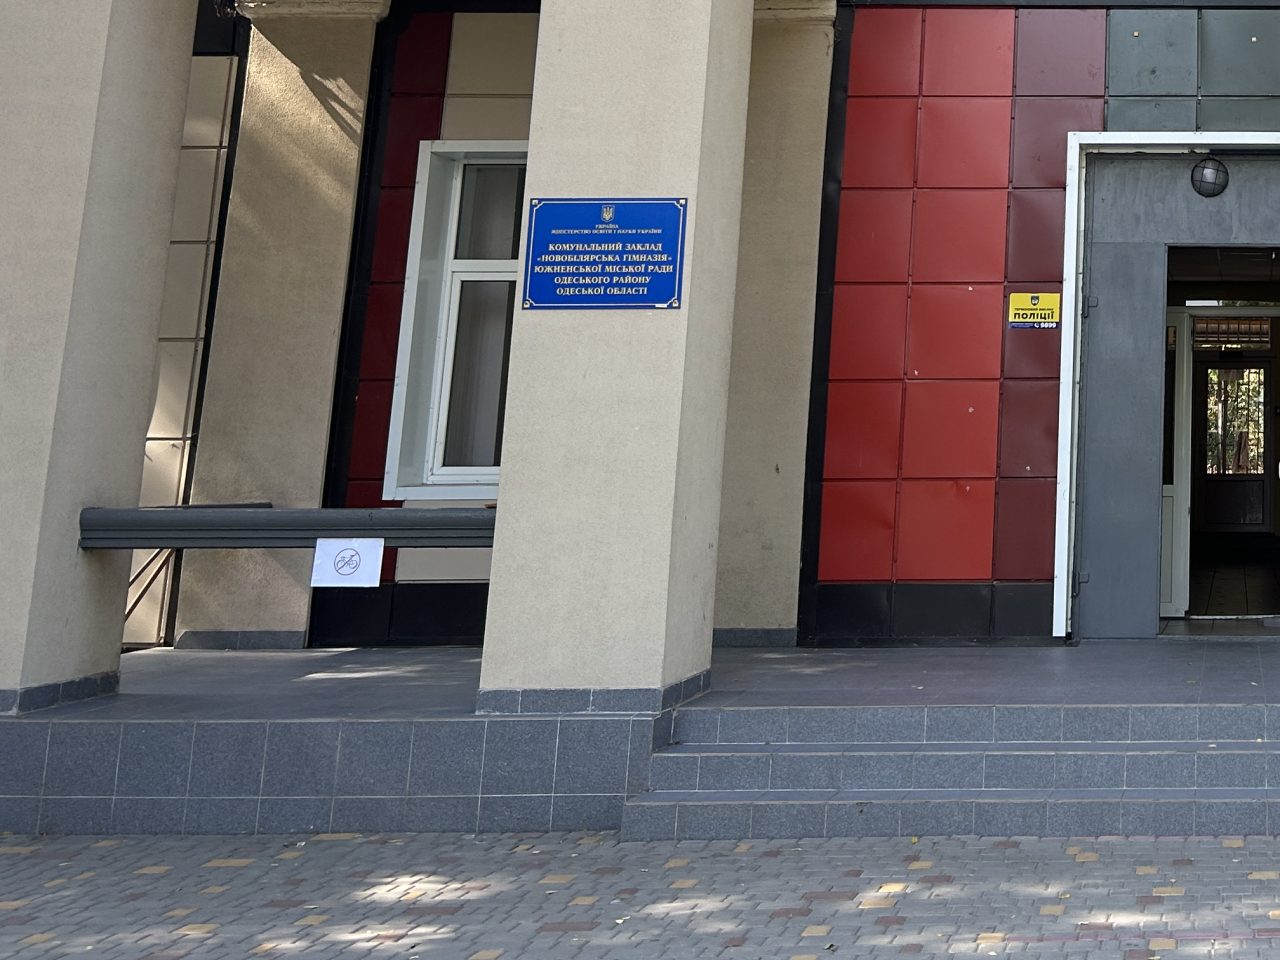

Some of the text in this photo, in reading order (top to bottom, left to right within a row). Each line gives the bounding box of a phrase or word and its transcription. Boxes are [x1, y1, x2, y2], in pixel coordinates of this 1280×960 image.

[549, 242, 662, 251] КОМУНАЛЬНИЙ ЗАКЛАД
[537, 254, 672, 262] «НОВОБІЛЯРСЬКА ГІМНАЗІЯ»
[534, 265, 673, 274] ЮЖНЕНСЬКОЇ МІСЬКОЇ РАДИ
[554, 275, 652, 285] ОДЕСЬКОГО РАЙОНУ
[556, 286, 648, 295] ОДЕСЬКОЇ ОБЛАСТІ
[1014, 311, 1054, 320] ПОЛІЦІЇ
